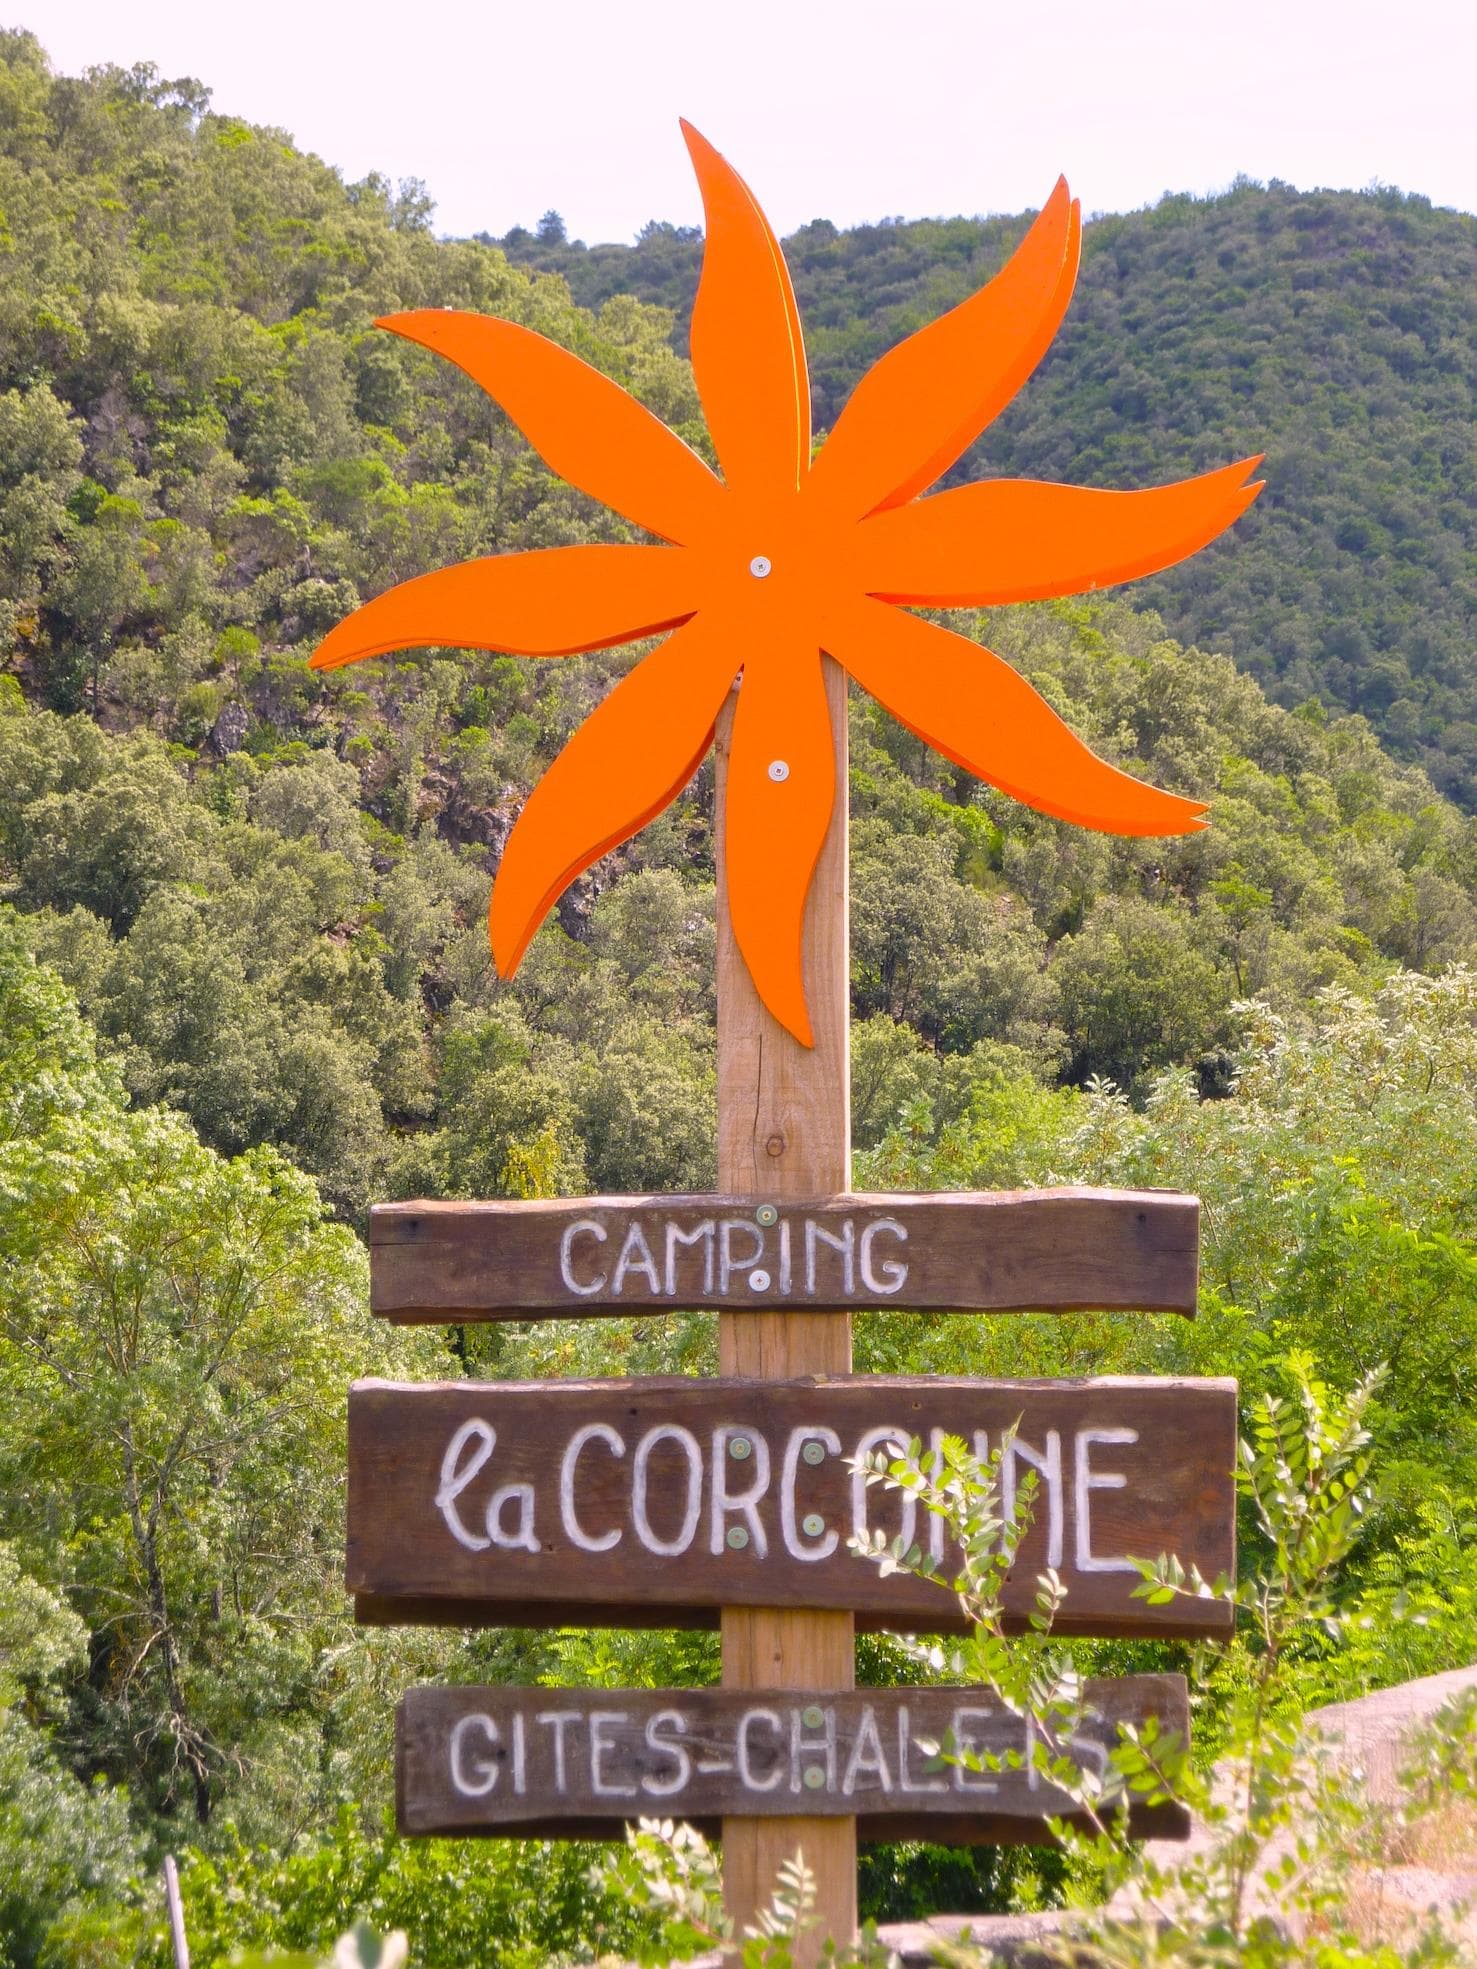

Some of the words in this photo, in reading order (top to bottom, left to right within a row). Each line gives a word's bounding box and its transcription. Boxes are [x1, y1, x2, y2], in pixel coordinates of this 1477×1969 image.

[560, 1218, 909, 1297] CAMPING
[434, 1416, 542, 1553] la
[559, 1422, 1140, 1572] CORCONNE
